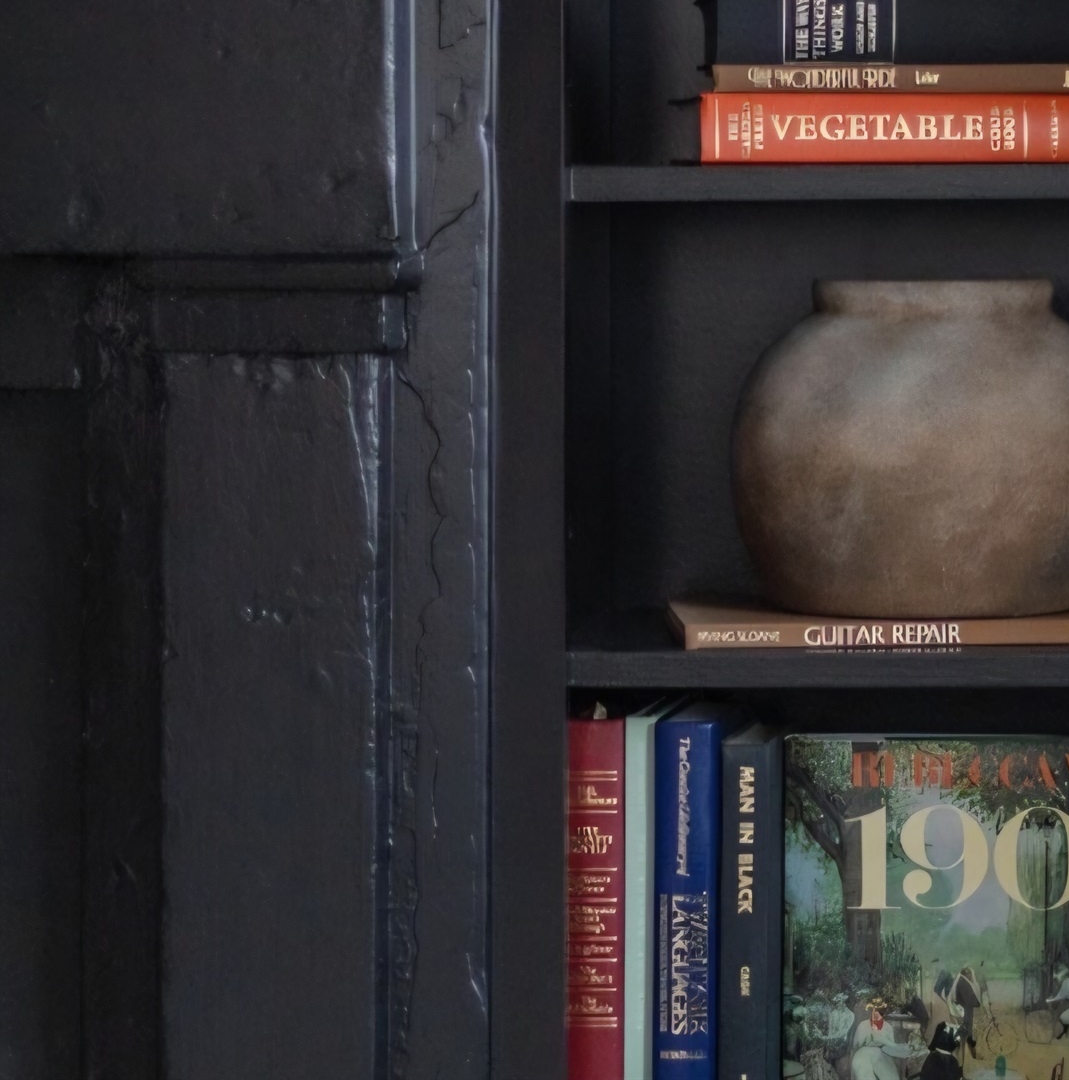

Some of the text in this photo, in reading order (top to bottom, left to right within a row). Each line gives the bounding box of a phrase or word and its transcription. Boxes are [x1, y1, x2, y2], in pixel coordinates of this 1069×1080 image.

[772, 114, 983, 141] VEGETABLE
[804, 626, 884, 646] GUITAR
[892, 623, 961, 645] REPAIR
[737, 766, 755, 914] MAN IN BLACK
